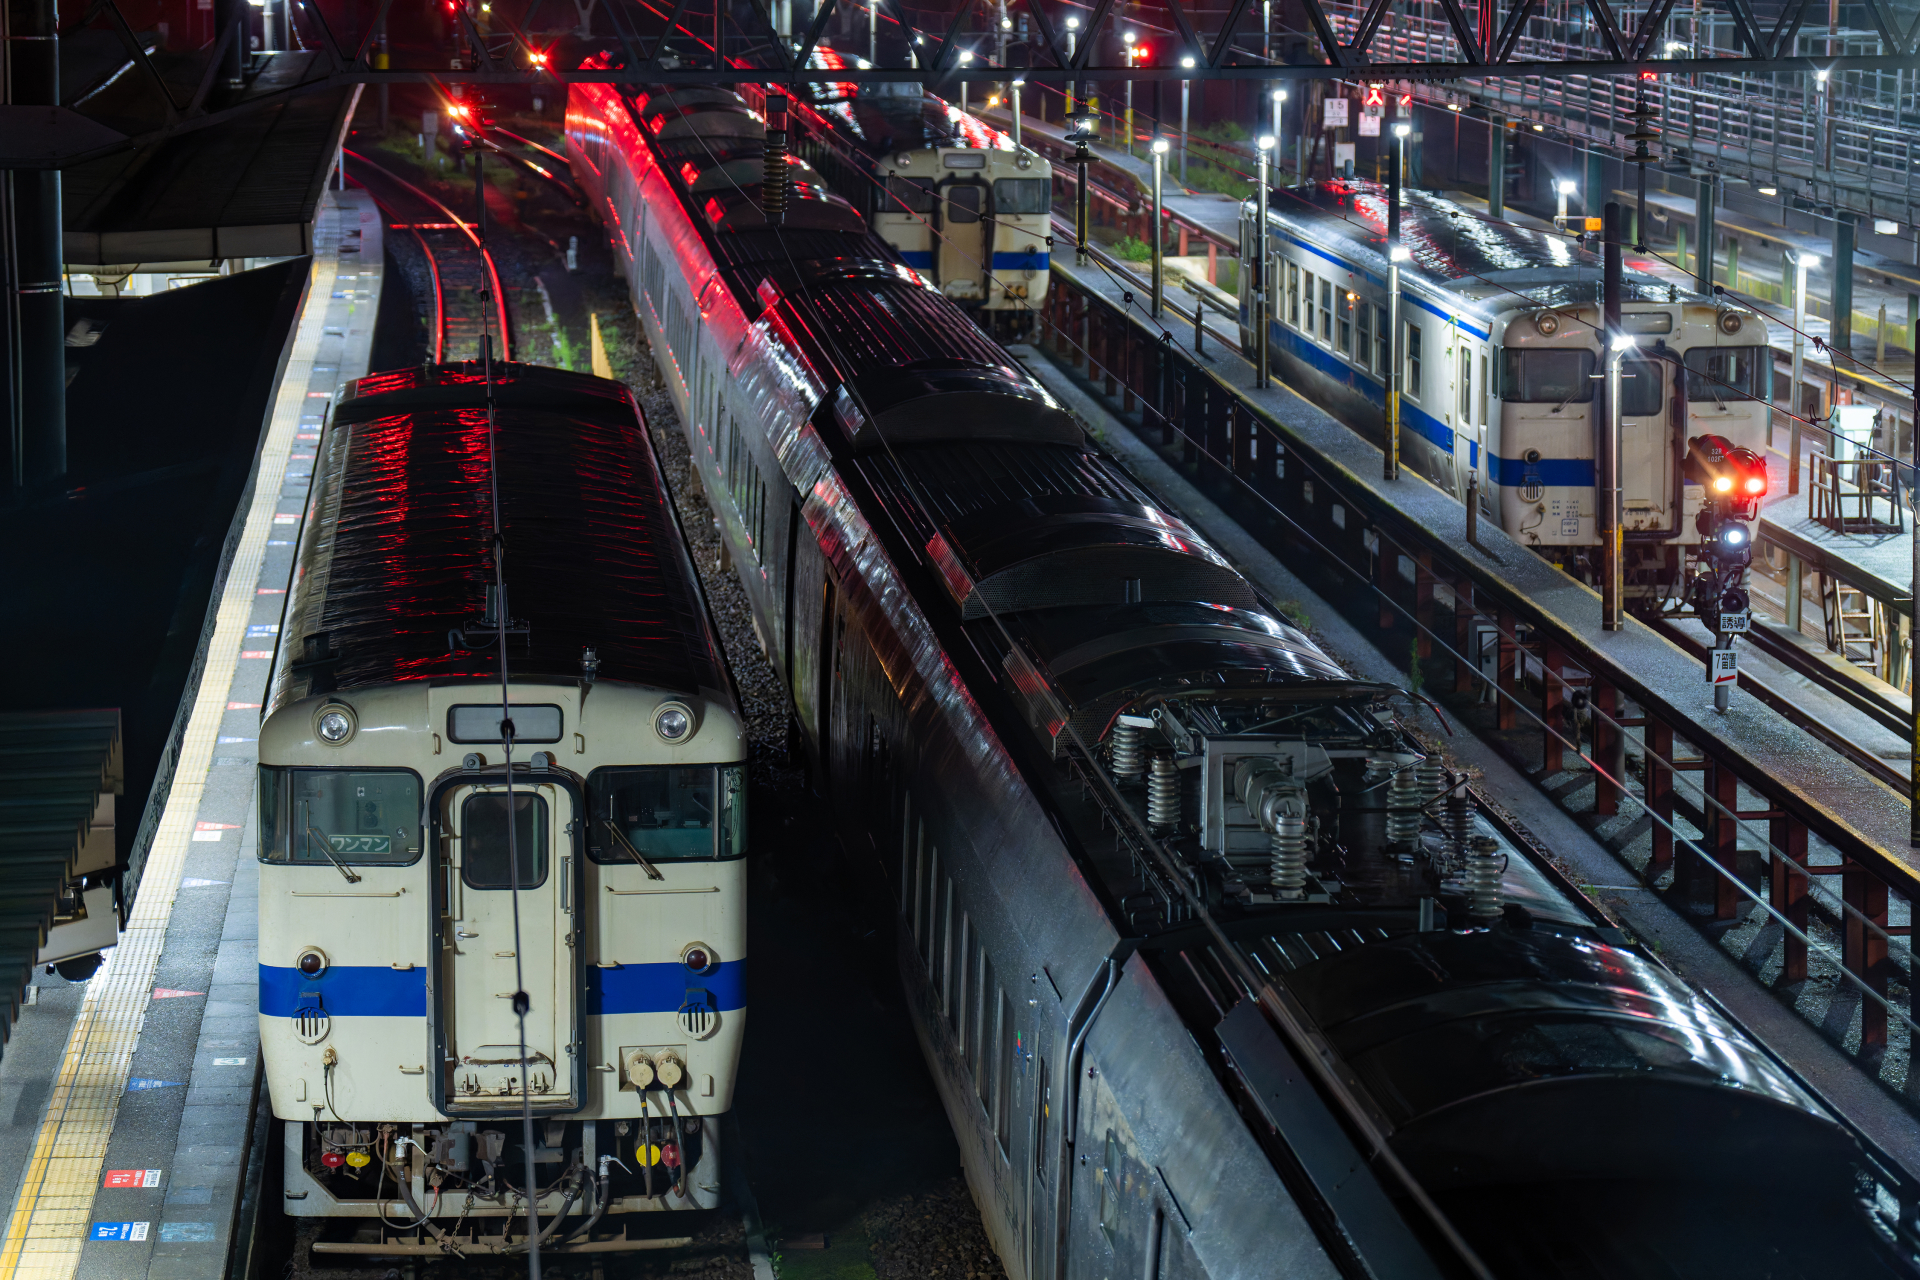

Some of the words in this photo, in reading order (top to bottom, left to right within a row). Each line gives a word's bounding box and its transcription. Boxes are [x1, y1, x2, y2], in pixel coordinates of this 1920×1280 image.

[1721, 616, 1746, 630] 誘導
[1715, 652, 1737, 670] 7留置
[330, 837, 388, 851] ワンマン
